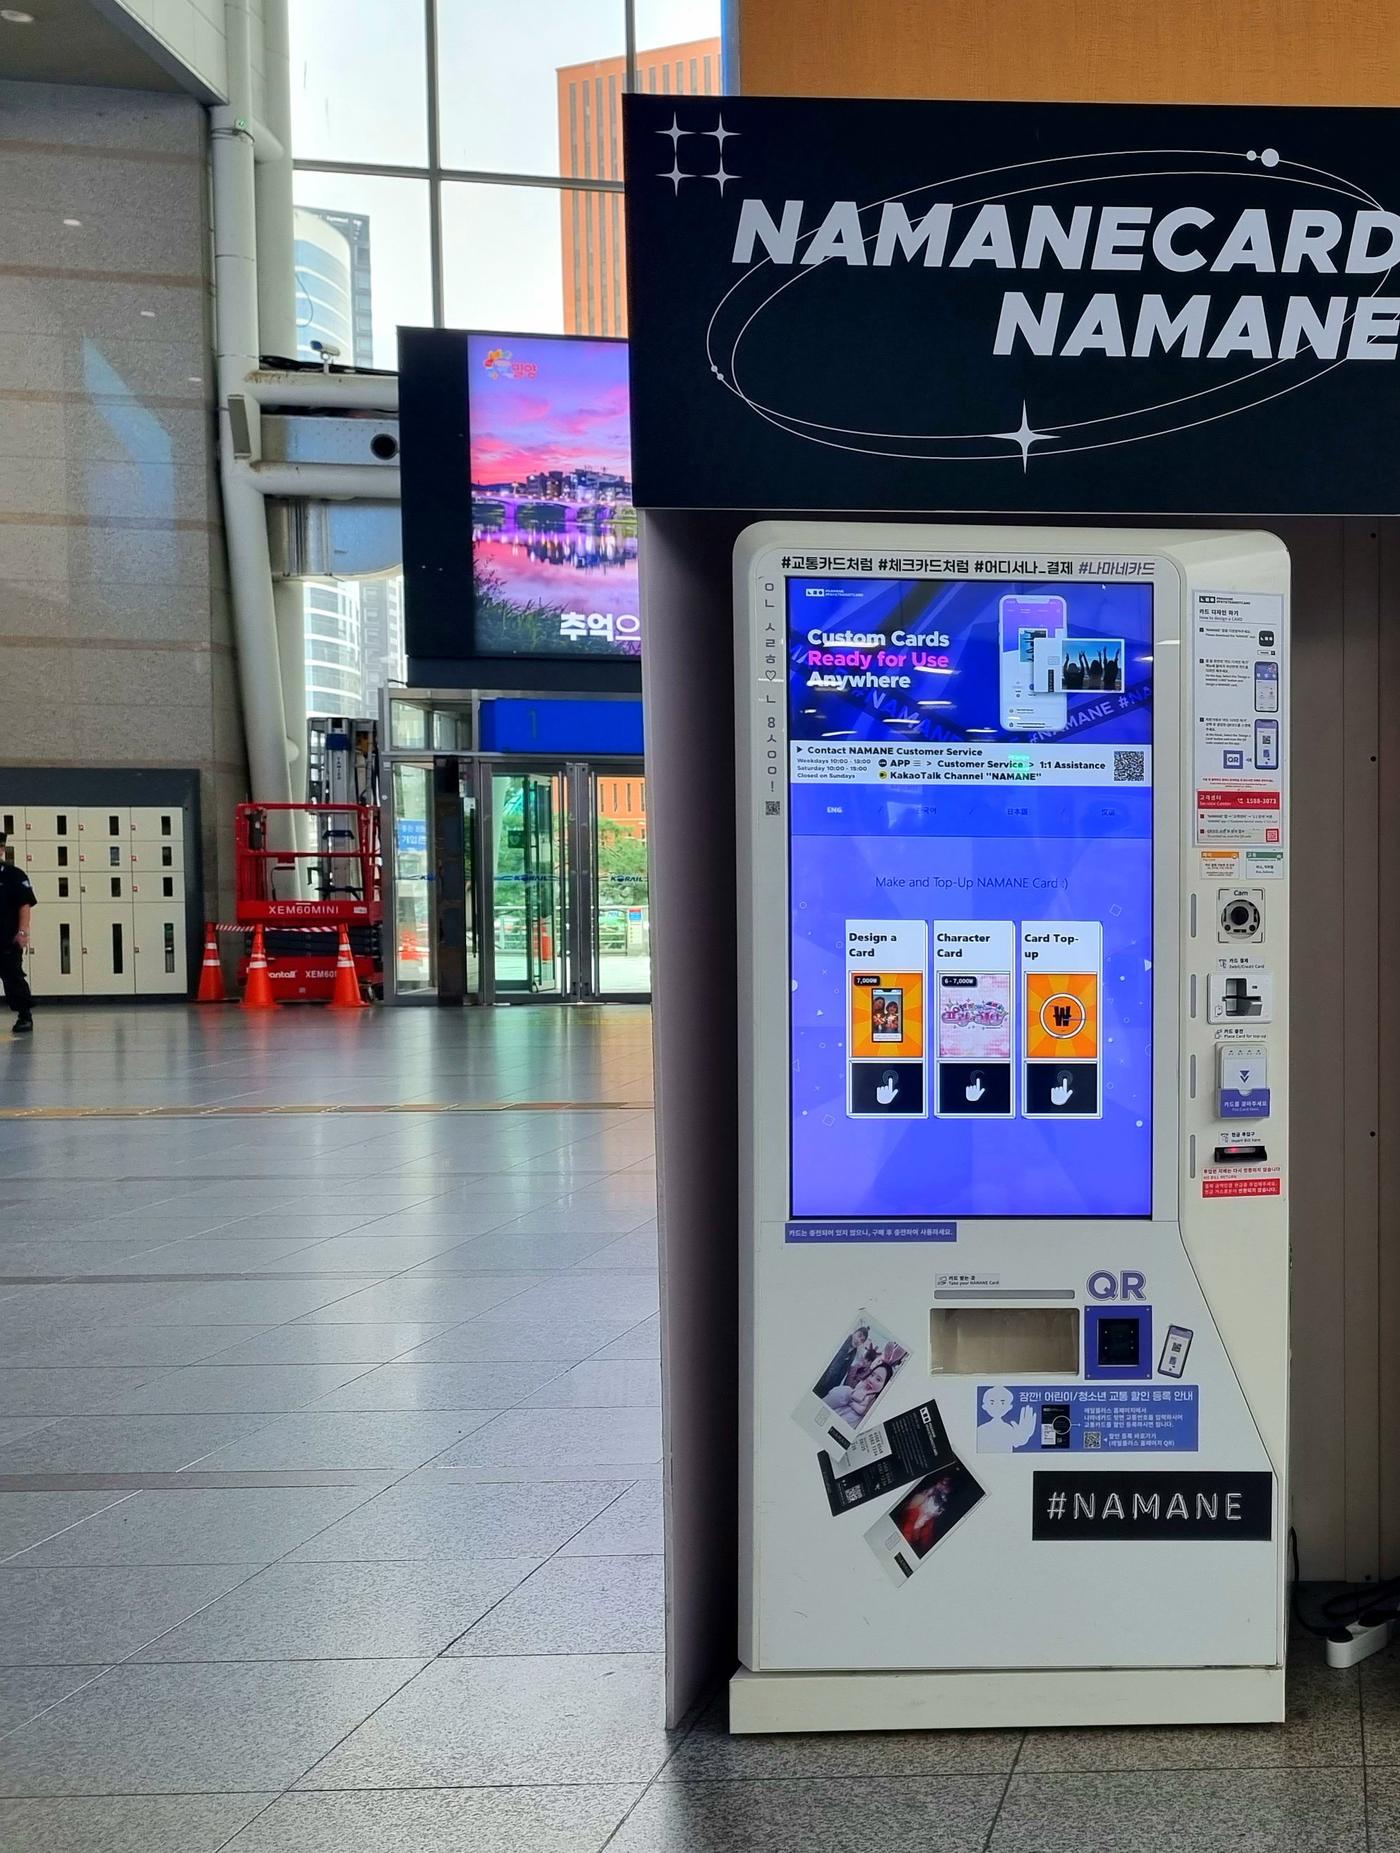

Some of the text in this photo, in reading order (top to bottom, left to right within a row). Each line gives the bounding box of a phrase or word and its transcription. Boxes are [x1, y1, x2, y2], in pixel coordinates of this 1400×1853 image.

[781, 556, 1156, 576] #교통카드처럼 #체크카드처럼 #어디서나_결제 #나마네카드
[807, 629, 950, 647] Custom Cards
[807, 650, 949, 670] Ready for Use
[807, 671, 911, 690] Anywhere
[807, 746, 983, 757] Contact NAMANE Customer Service
[937, 760, 985, 768] Customer
[987, 760, 1024, 769] Service
[1039, 761, 1052, 769] 1:1
[1054, 761, 1106, 770] Assistance
[1227, 755, 1240, 764] QR
[890, 771, 1042, 781] KakaoTalk Channel "NAMANE"
[610, 875, 644, 883] KORAIL
[875, 876, 1058, 890] Make and Top-Up NAMANE Card
[268, 905, 339, 915] XEM60MINI
[849, 932, 897, 944] Design a
[936, 933, 991, 943] Character
[1024, 934, 1079, 945] Card Top-
[848, 948, 875, 957] Card
[936, 949, 963, 958] Card
[1024, 950, 1039, 960] up
[268, 970, 297, 979] antall
[1086, 1270, 1147, 1301] QR
[1019, 1391, 1193, 1402] 잠깐! 어린이/청소년 교통 할인 등록 안내
[1046, 1491, 1243, 1522] #NAMANE
